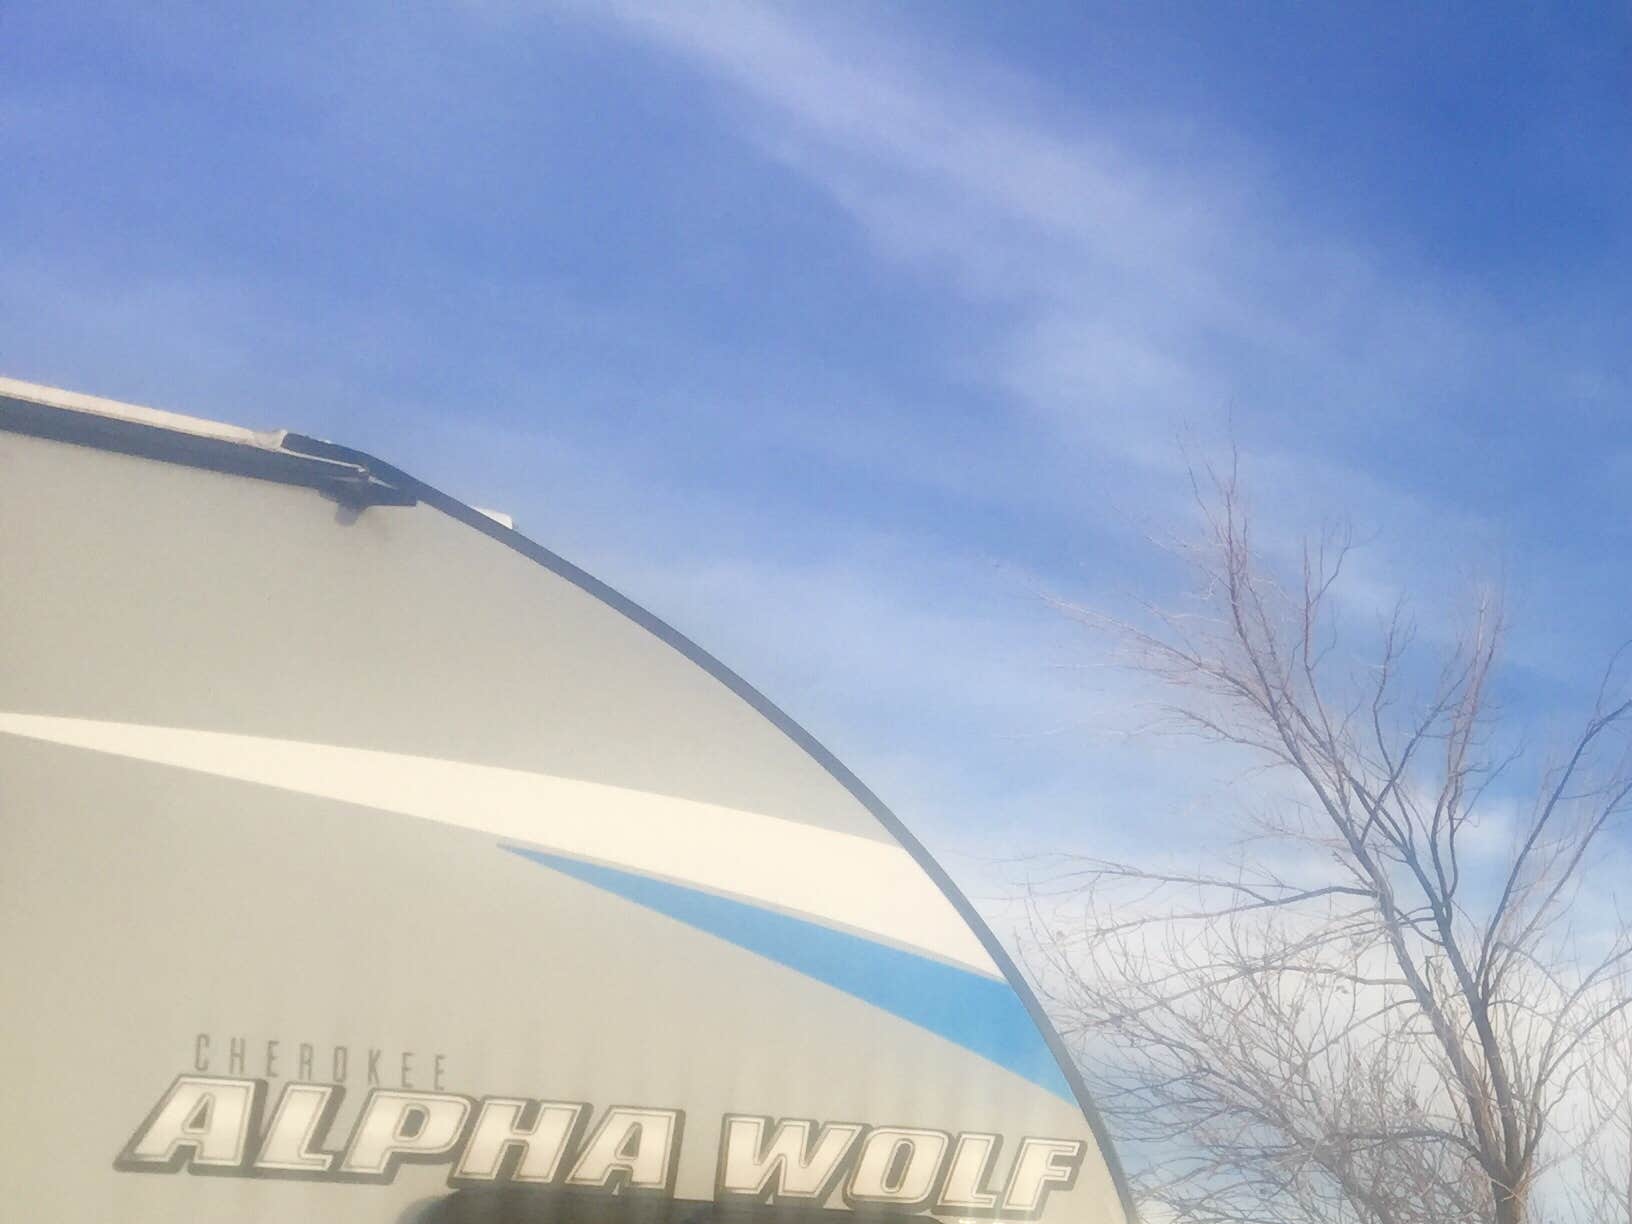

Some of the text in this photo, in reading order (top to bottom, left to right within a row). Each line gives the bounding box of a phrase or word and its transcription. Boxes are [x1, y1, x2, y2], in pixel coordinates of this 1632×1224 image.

[194, 1033, 447, 1091] CHEROKEE
[112, 1073, 1088, 1220] ALPHA WOLF
